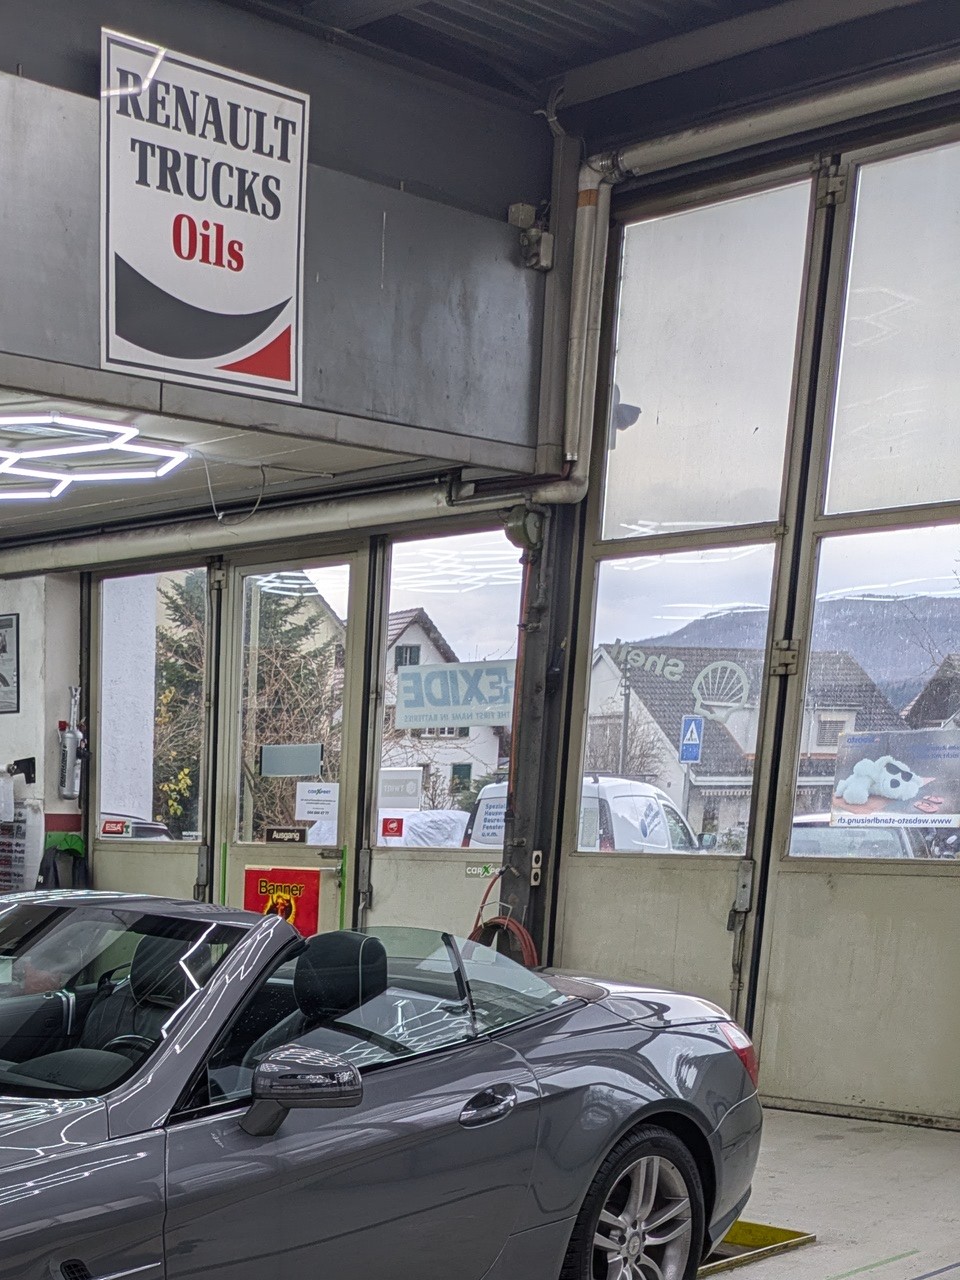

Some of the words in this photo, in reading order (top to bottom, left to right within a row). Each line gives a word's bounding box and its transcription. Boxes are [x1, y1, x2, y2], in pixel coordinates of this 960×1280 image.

[115, 67, 297, 163] RENAULT
[130, 137, 282, 221] TRUCKS
[172, 213, 245, 272] Oils
[272, 830, 300, 841] Ausgang
[258, 879, 304, 897] Banner
